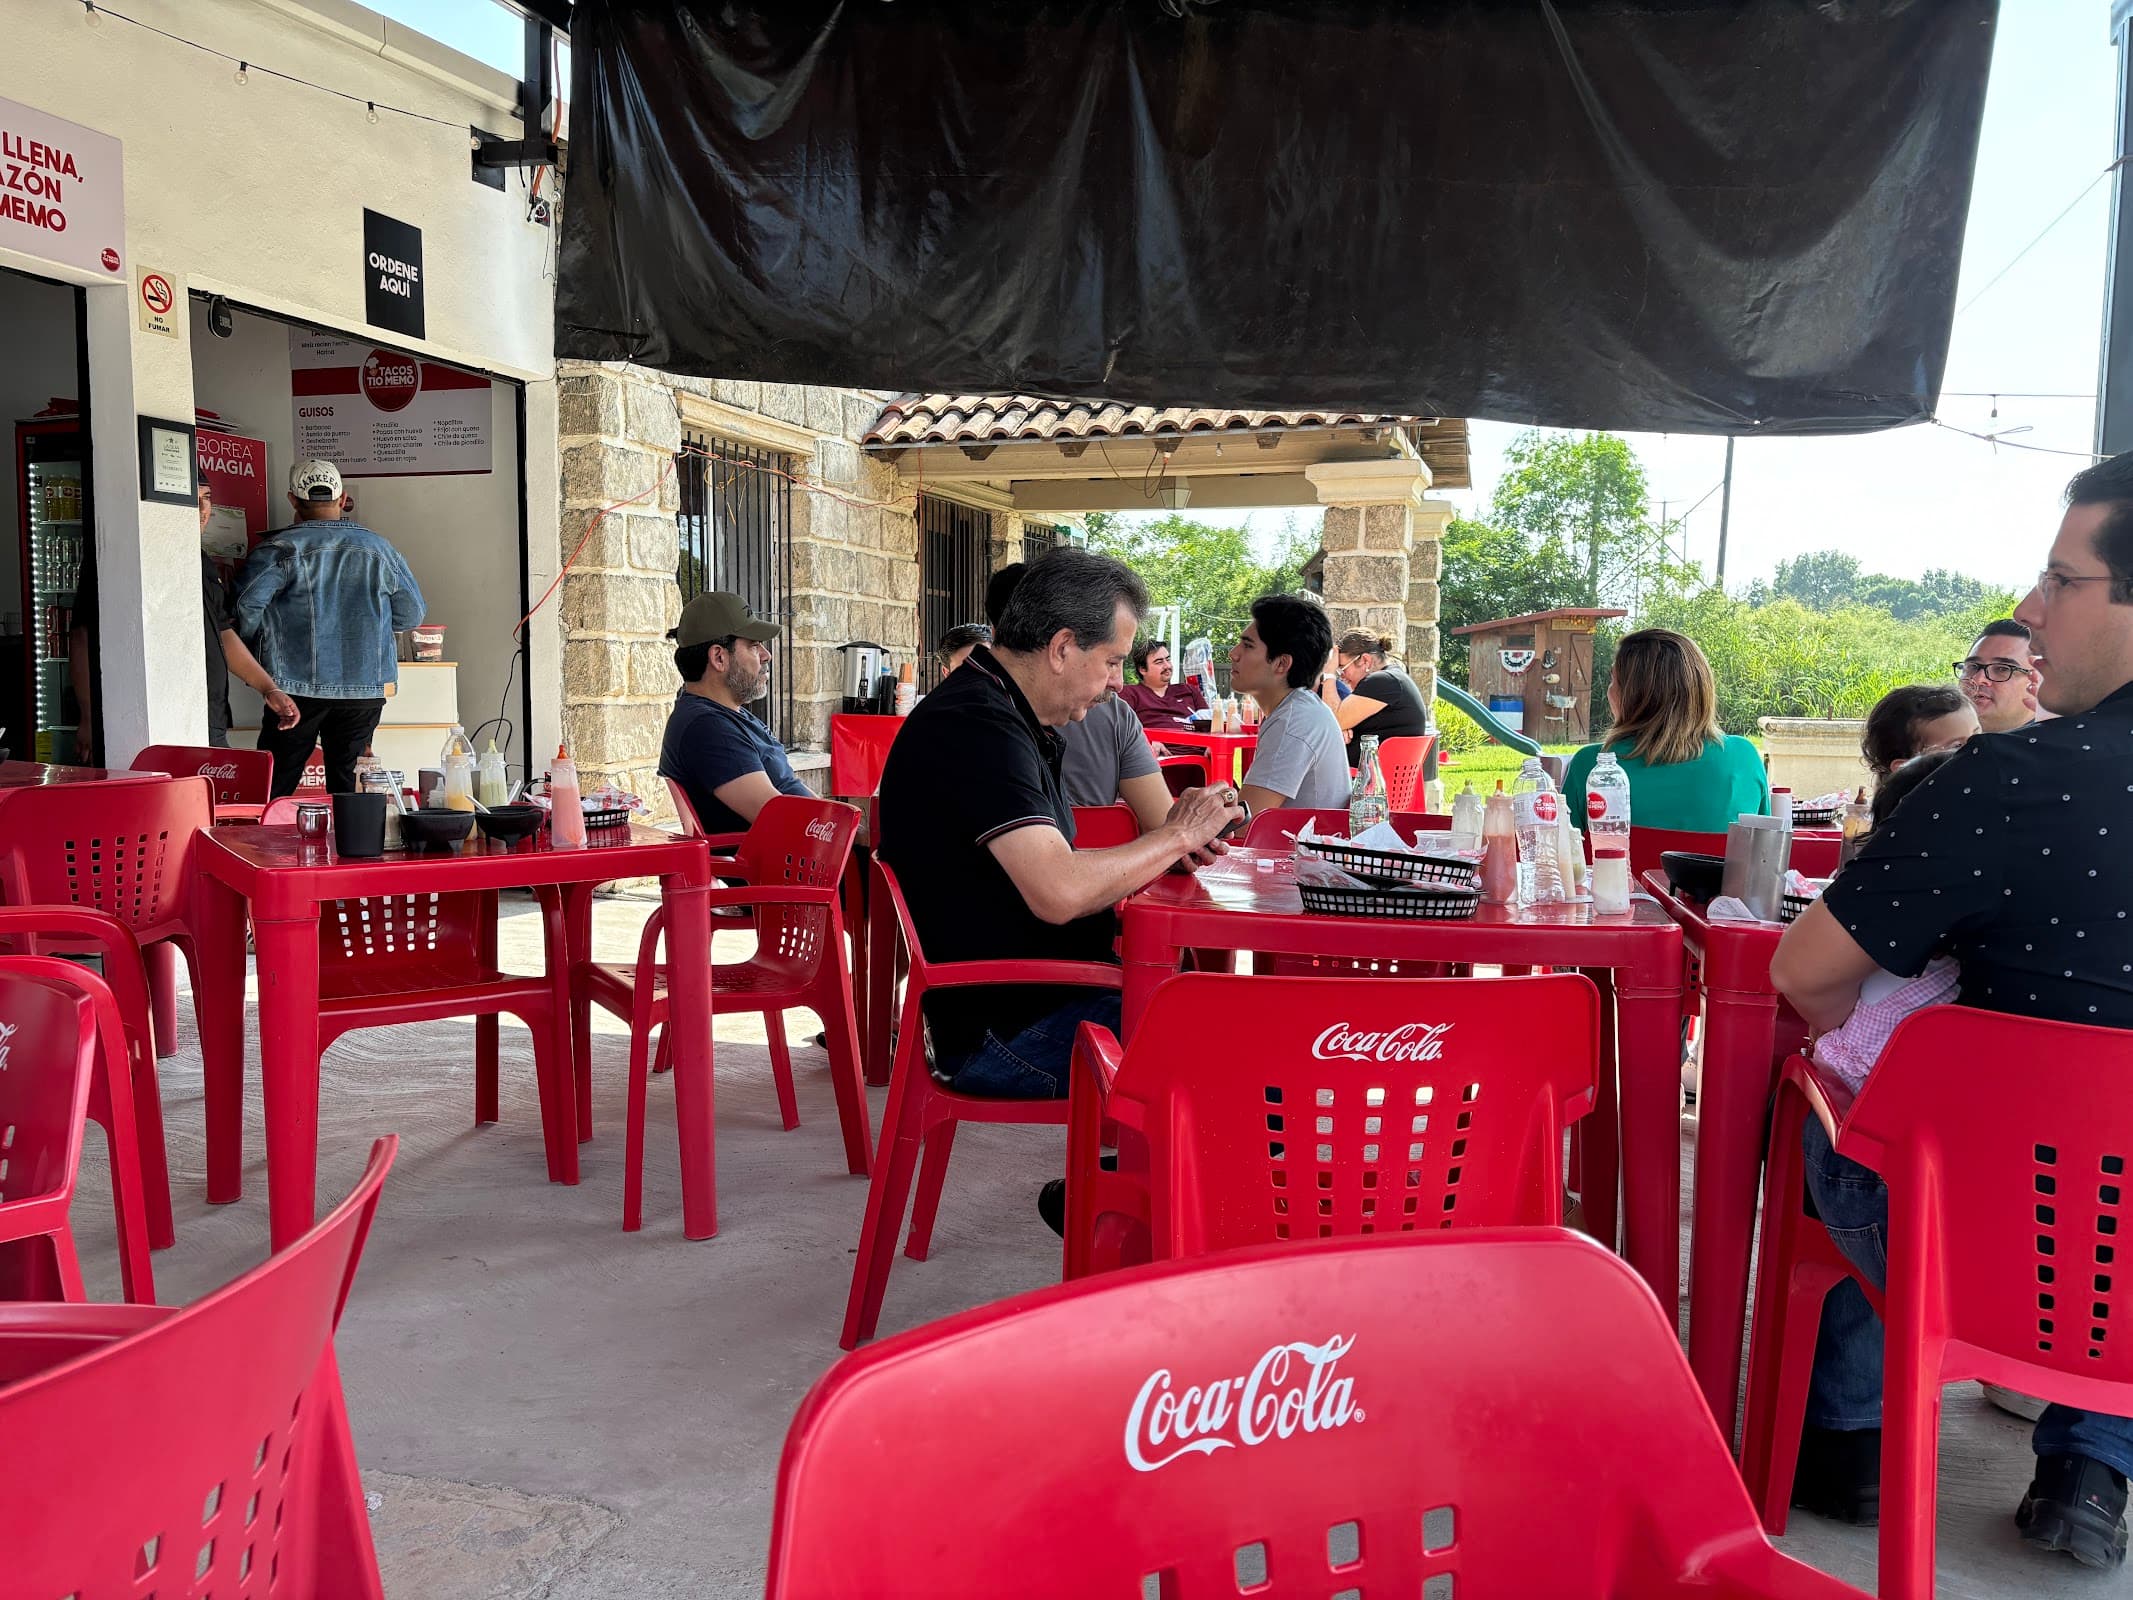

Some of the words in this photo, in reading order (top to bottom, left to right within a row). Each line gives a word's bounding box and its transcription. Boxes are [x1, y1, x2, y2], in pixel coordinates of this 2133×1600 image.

[3, 131, 84, 183] LLENA,
[369, 252, 418, 282] ORDENE
[380, 275, 410, 298] AQUÍ
[148, 323, 170, 333] FUMAR
[154, 316, 164, 324] NO
[367, 376, 383, 386] TIO
[385, 375, 415, 385] MEMO
[379, 366, 414, 376] TACOS
[299, 407, 334, 417] GUISOS
[199, 454, 255, 478] MAGIA
[298, 474, 339, 490] YANKEES
[1312, 1022, 1455, 1062] Coca-Cola
[1125, 1333, 1358, 1472] Coca-Cola
